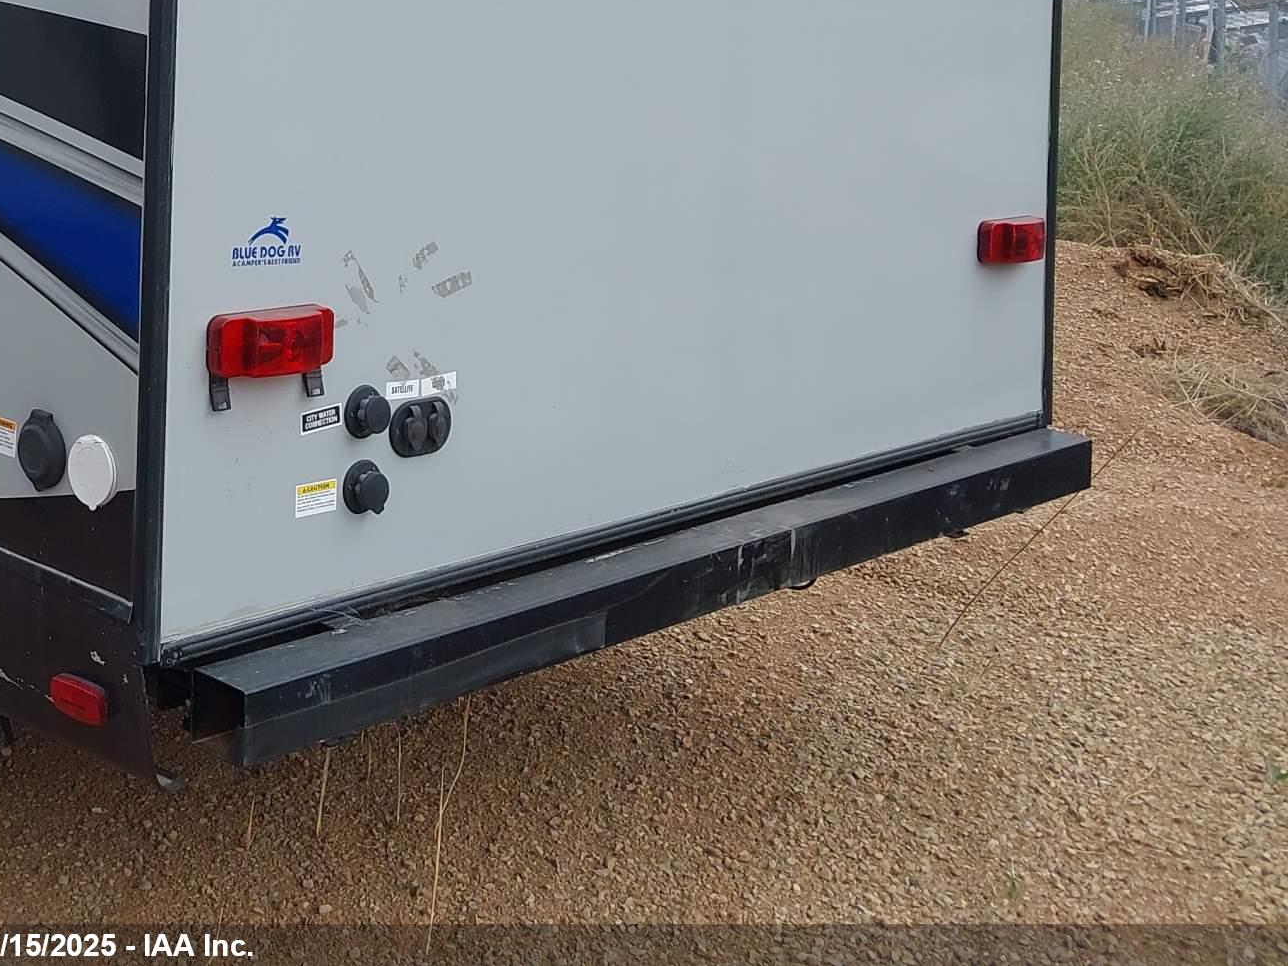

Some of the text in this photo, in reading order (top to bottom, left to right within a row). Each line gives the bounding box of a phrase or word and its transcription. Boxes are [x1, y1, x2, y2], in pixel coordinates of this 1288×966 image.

[232, 244, 301, 260] BLUE DOG RV
[281, 257, 301, 265] FRIEND
[392, 384, 414, 394] SATELLITE
[304, 415, 338, 430] CONNECTION
[306, 414, 318, 423] CITY
[306, 482, 330, 492] CAUTION
